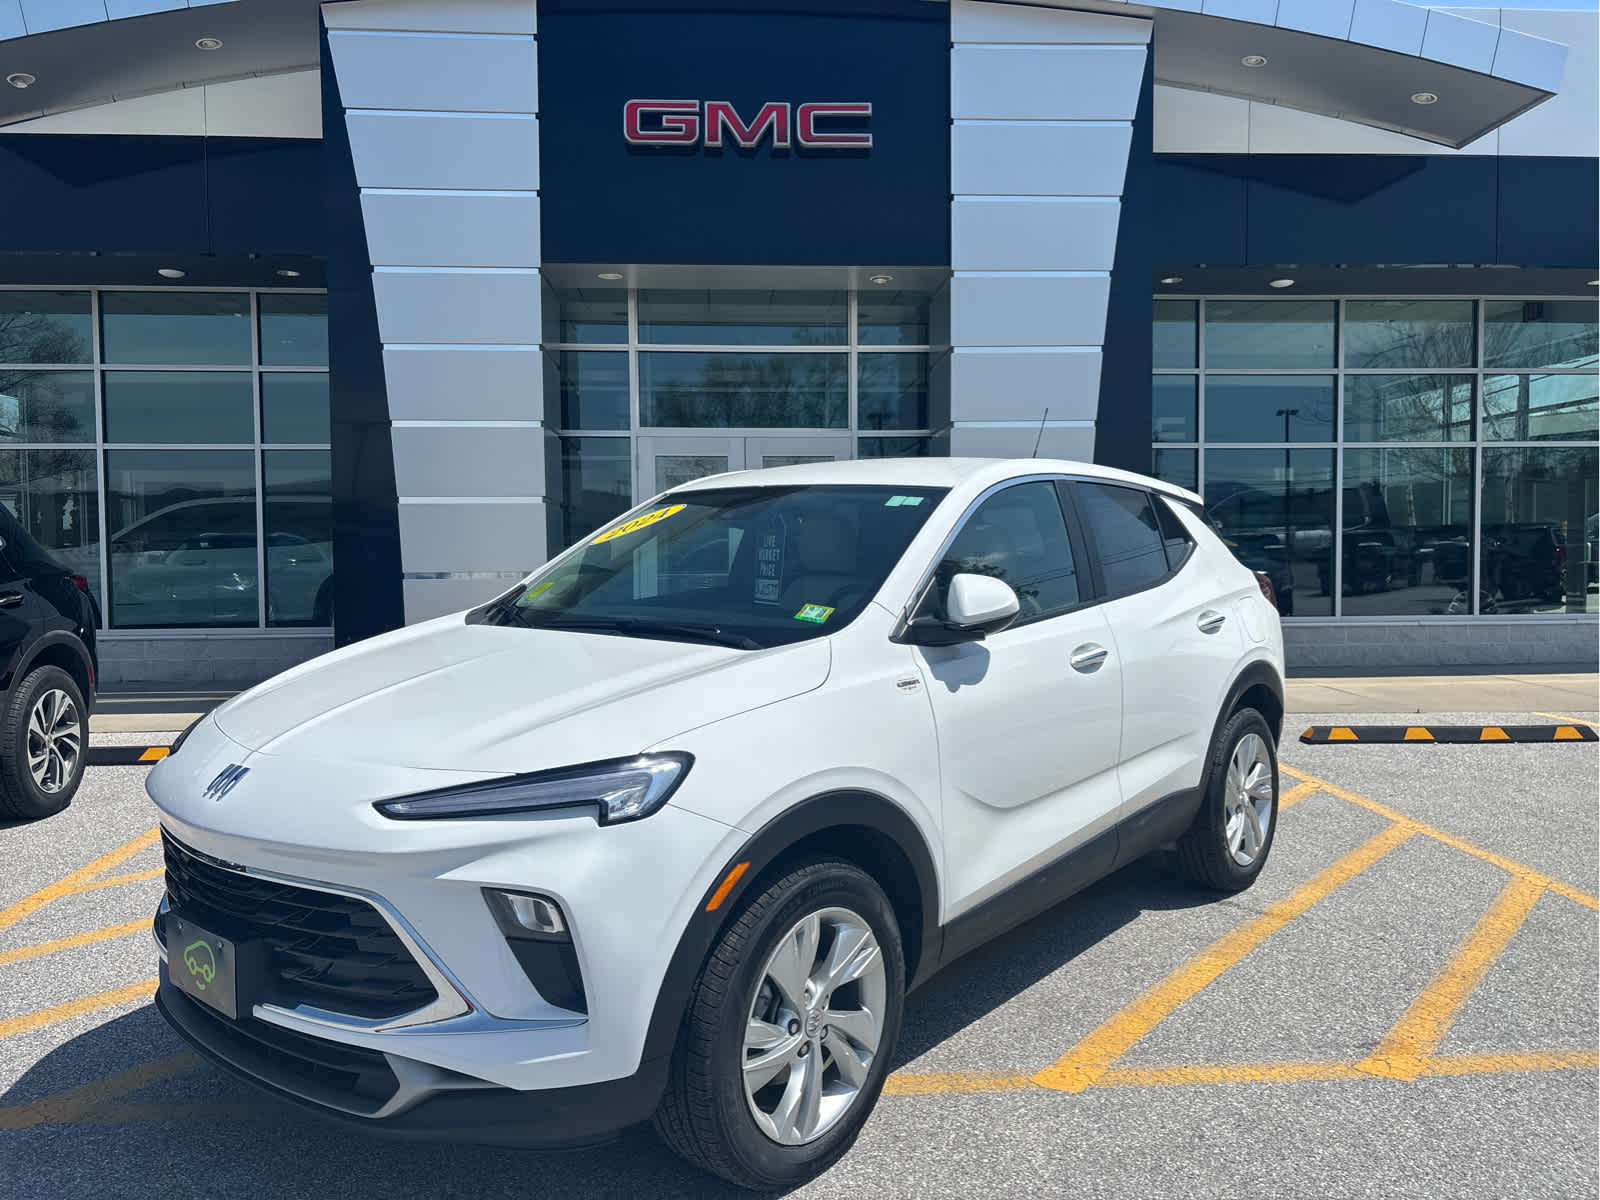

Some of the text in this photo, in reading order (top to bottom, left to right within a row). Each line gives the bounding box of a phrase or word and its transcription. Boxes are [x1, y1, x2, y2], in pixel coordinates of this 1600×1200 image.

[624, 99, 873, 148] GMC
[604, 507, 672, 539] 2024
[763, 535, 777, 547] LIVE
